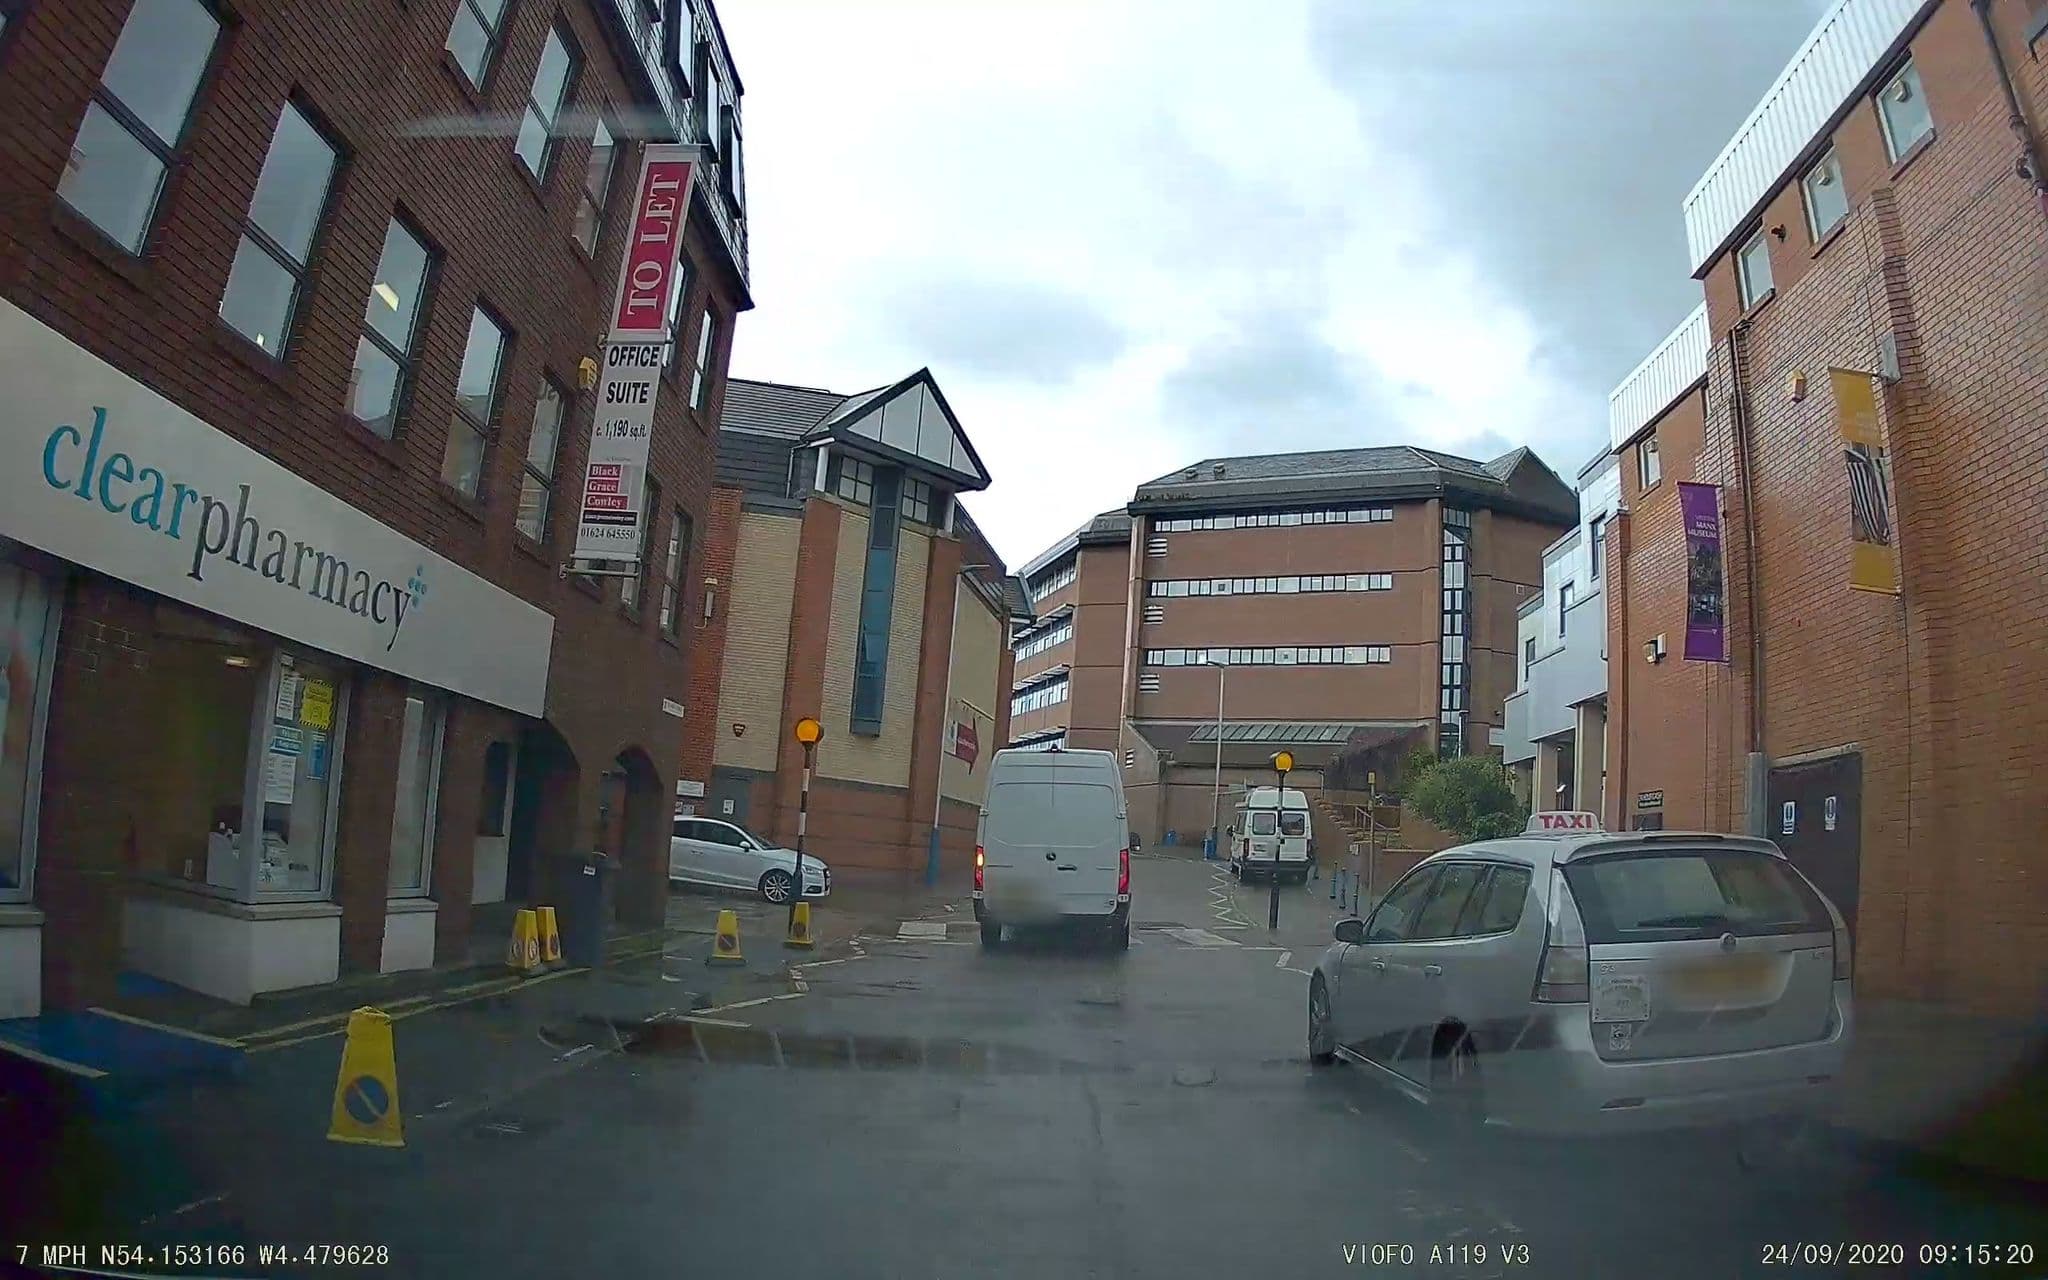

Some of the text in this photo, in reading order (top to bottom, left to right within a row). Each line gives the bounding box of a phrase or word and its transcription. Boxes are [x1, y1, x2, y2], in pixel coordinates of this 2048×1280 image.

[627, 173, 681, 316] TO LET
[609, 346, 660, 367] OFFICE
[606, 381, 650, 404] SUITE
[605, 419, 629, 440] 1,190
[591, 466, 618, 476] Black
[588, 481, 617, 492] Grace
[1696, 521, 1717, 531] MANX
[580, 528, 636, 540] 01624 645550
[1687, 528, 1718, 539] MUSEUM
[1539, 814, 1593, 829] TAXI
